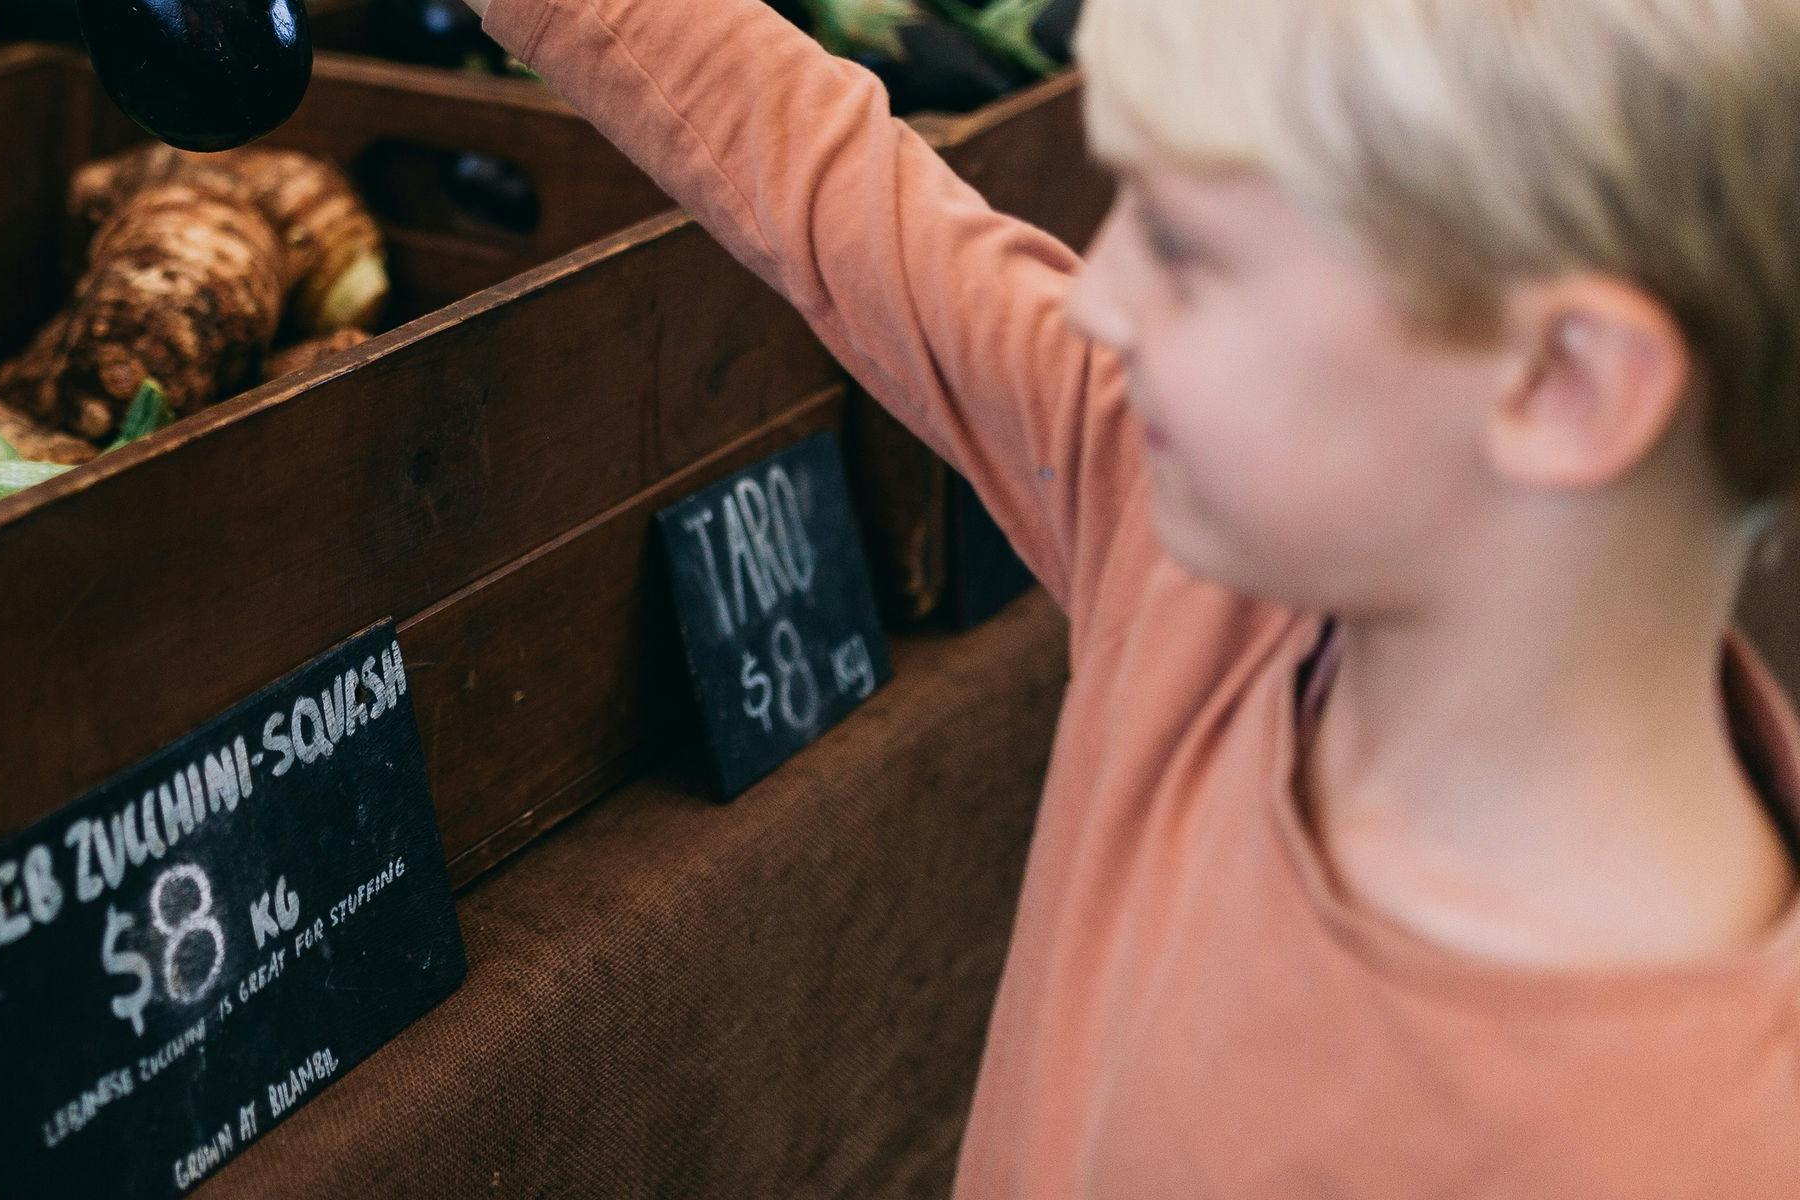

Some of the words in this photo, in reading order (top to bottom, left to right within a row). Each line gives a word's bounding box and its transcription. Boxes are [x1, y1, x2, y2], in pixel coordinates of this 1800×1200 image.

[683, 464, 815, 637] TARO
[102, 863, 226, 1038] $8
[250, 874, 301, 951] KG
[217, 995, 234, 1023] IS
[238, 948, 287, 1004] GREAT
[294, 917, 325, 959] FOR
[329, 856, 406, 928] STUFFING
[174, 1122, 234, 1191] GROWN
[239, 1099, 259, 1142] AT
[267, 1047, 339, 1119] BILAMBIL
